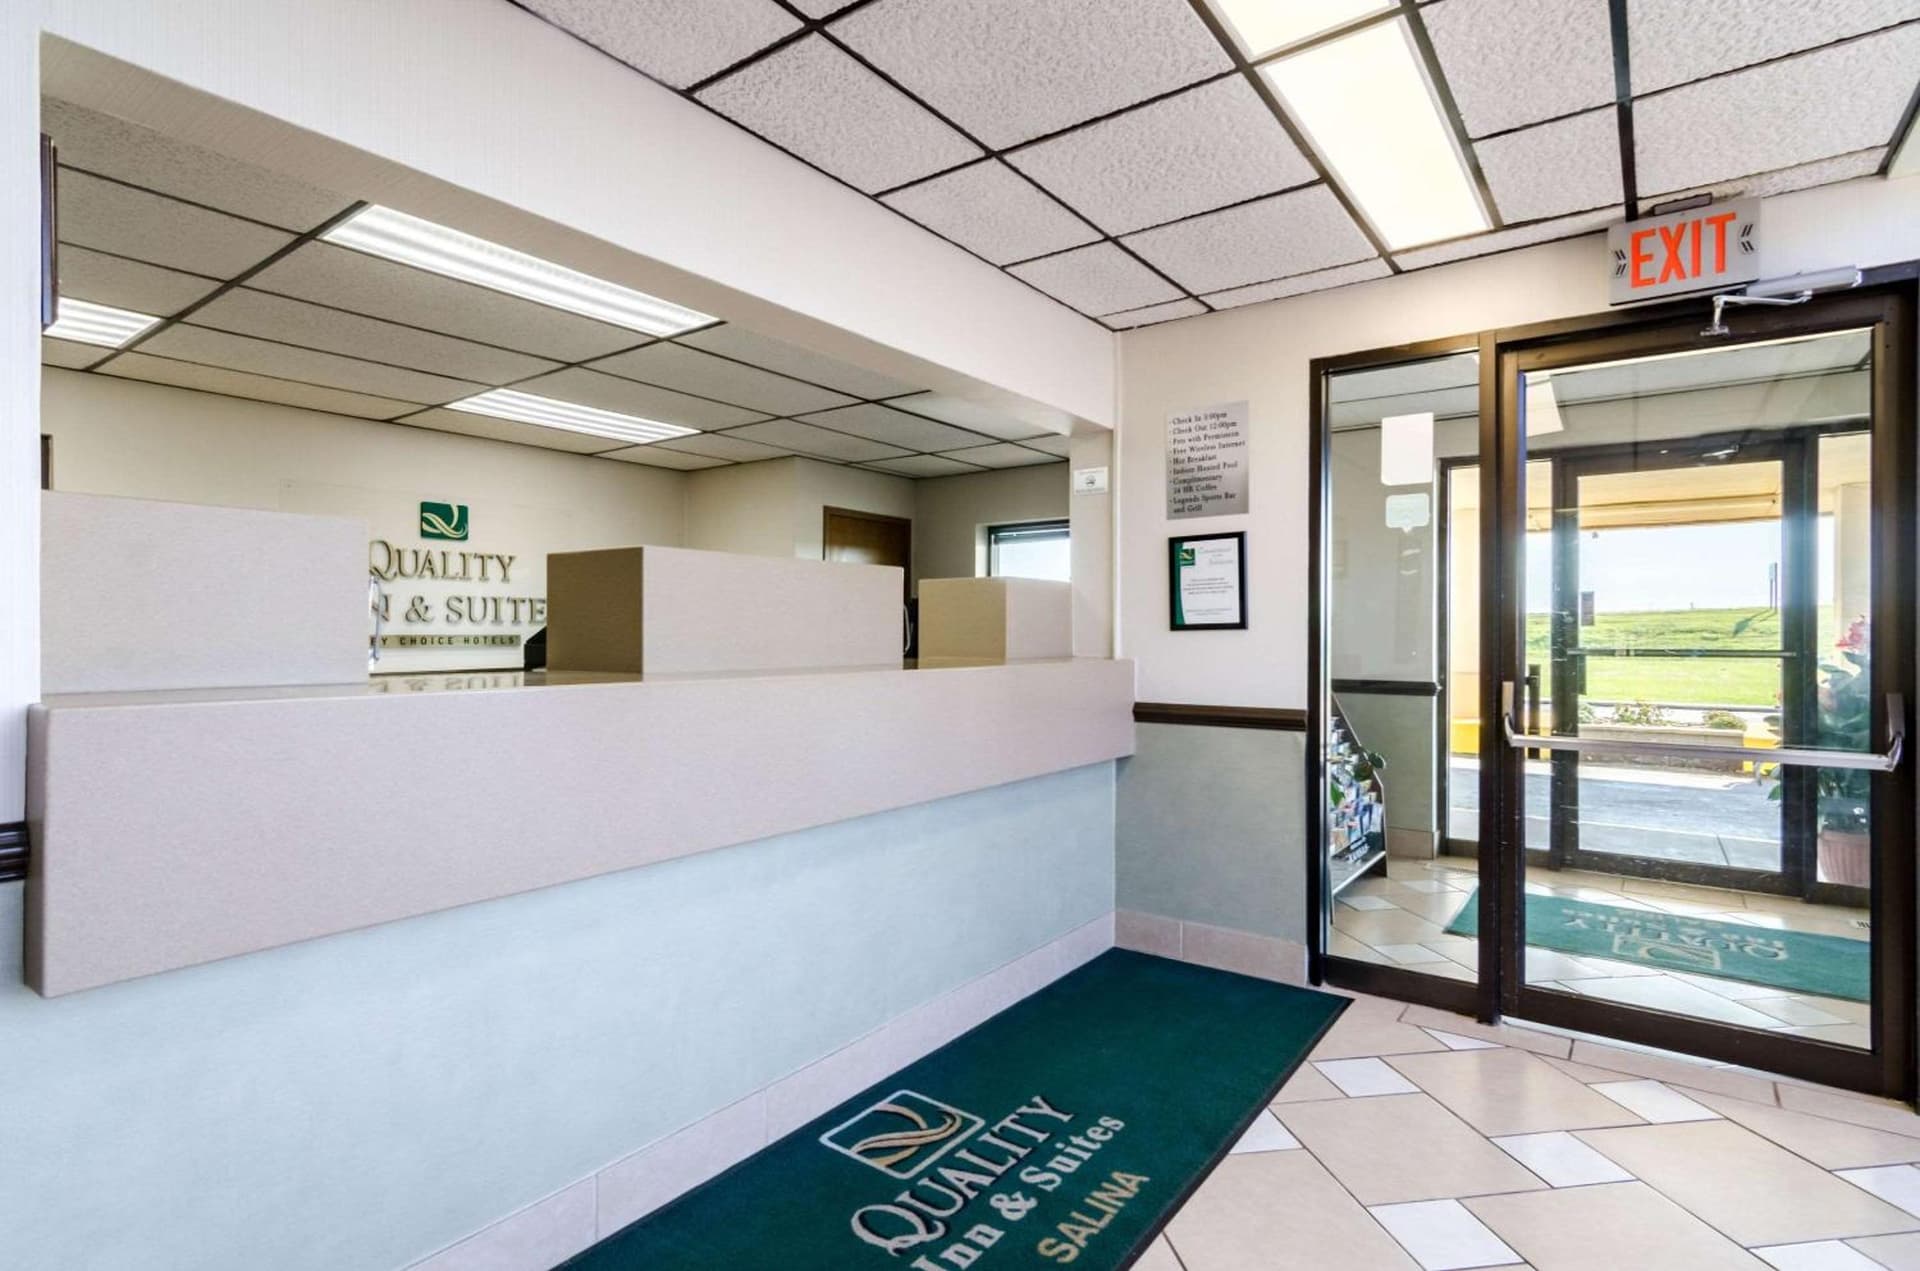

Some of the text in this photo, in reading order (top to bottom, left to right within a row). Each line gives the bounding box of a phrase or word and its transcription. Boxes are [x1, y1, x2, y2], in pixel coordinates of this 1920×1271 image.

[1631, 212, 1736, 288] EXIT
[1173, 416, 1192, 425] Check
[1173, 426, 1192, 434] Check
[1194, 424, 1207, 432] Out
[1173, 447, 1187, 455] Free
[1218, 440, 1246, 449] Internet
[1173, 454, 1217, 465] Hot Breakfast
[1223, 461, 1238, 469] Pool
[369, 540, 516, 583] QUALITY
[404, 594, 434, 624] &
[399, 635, 455, 647] CHOICE
[463, 636, 517, 646] HOTELS
[850, 1094, 1076, 1257] QUALITY
[909, 1115, 1126, 1271] Inn & Suites
[1037, 1170, 1152, 1264] SALINA
